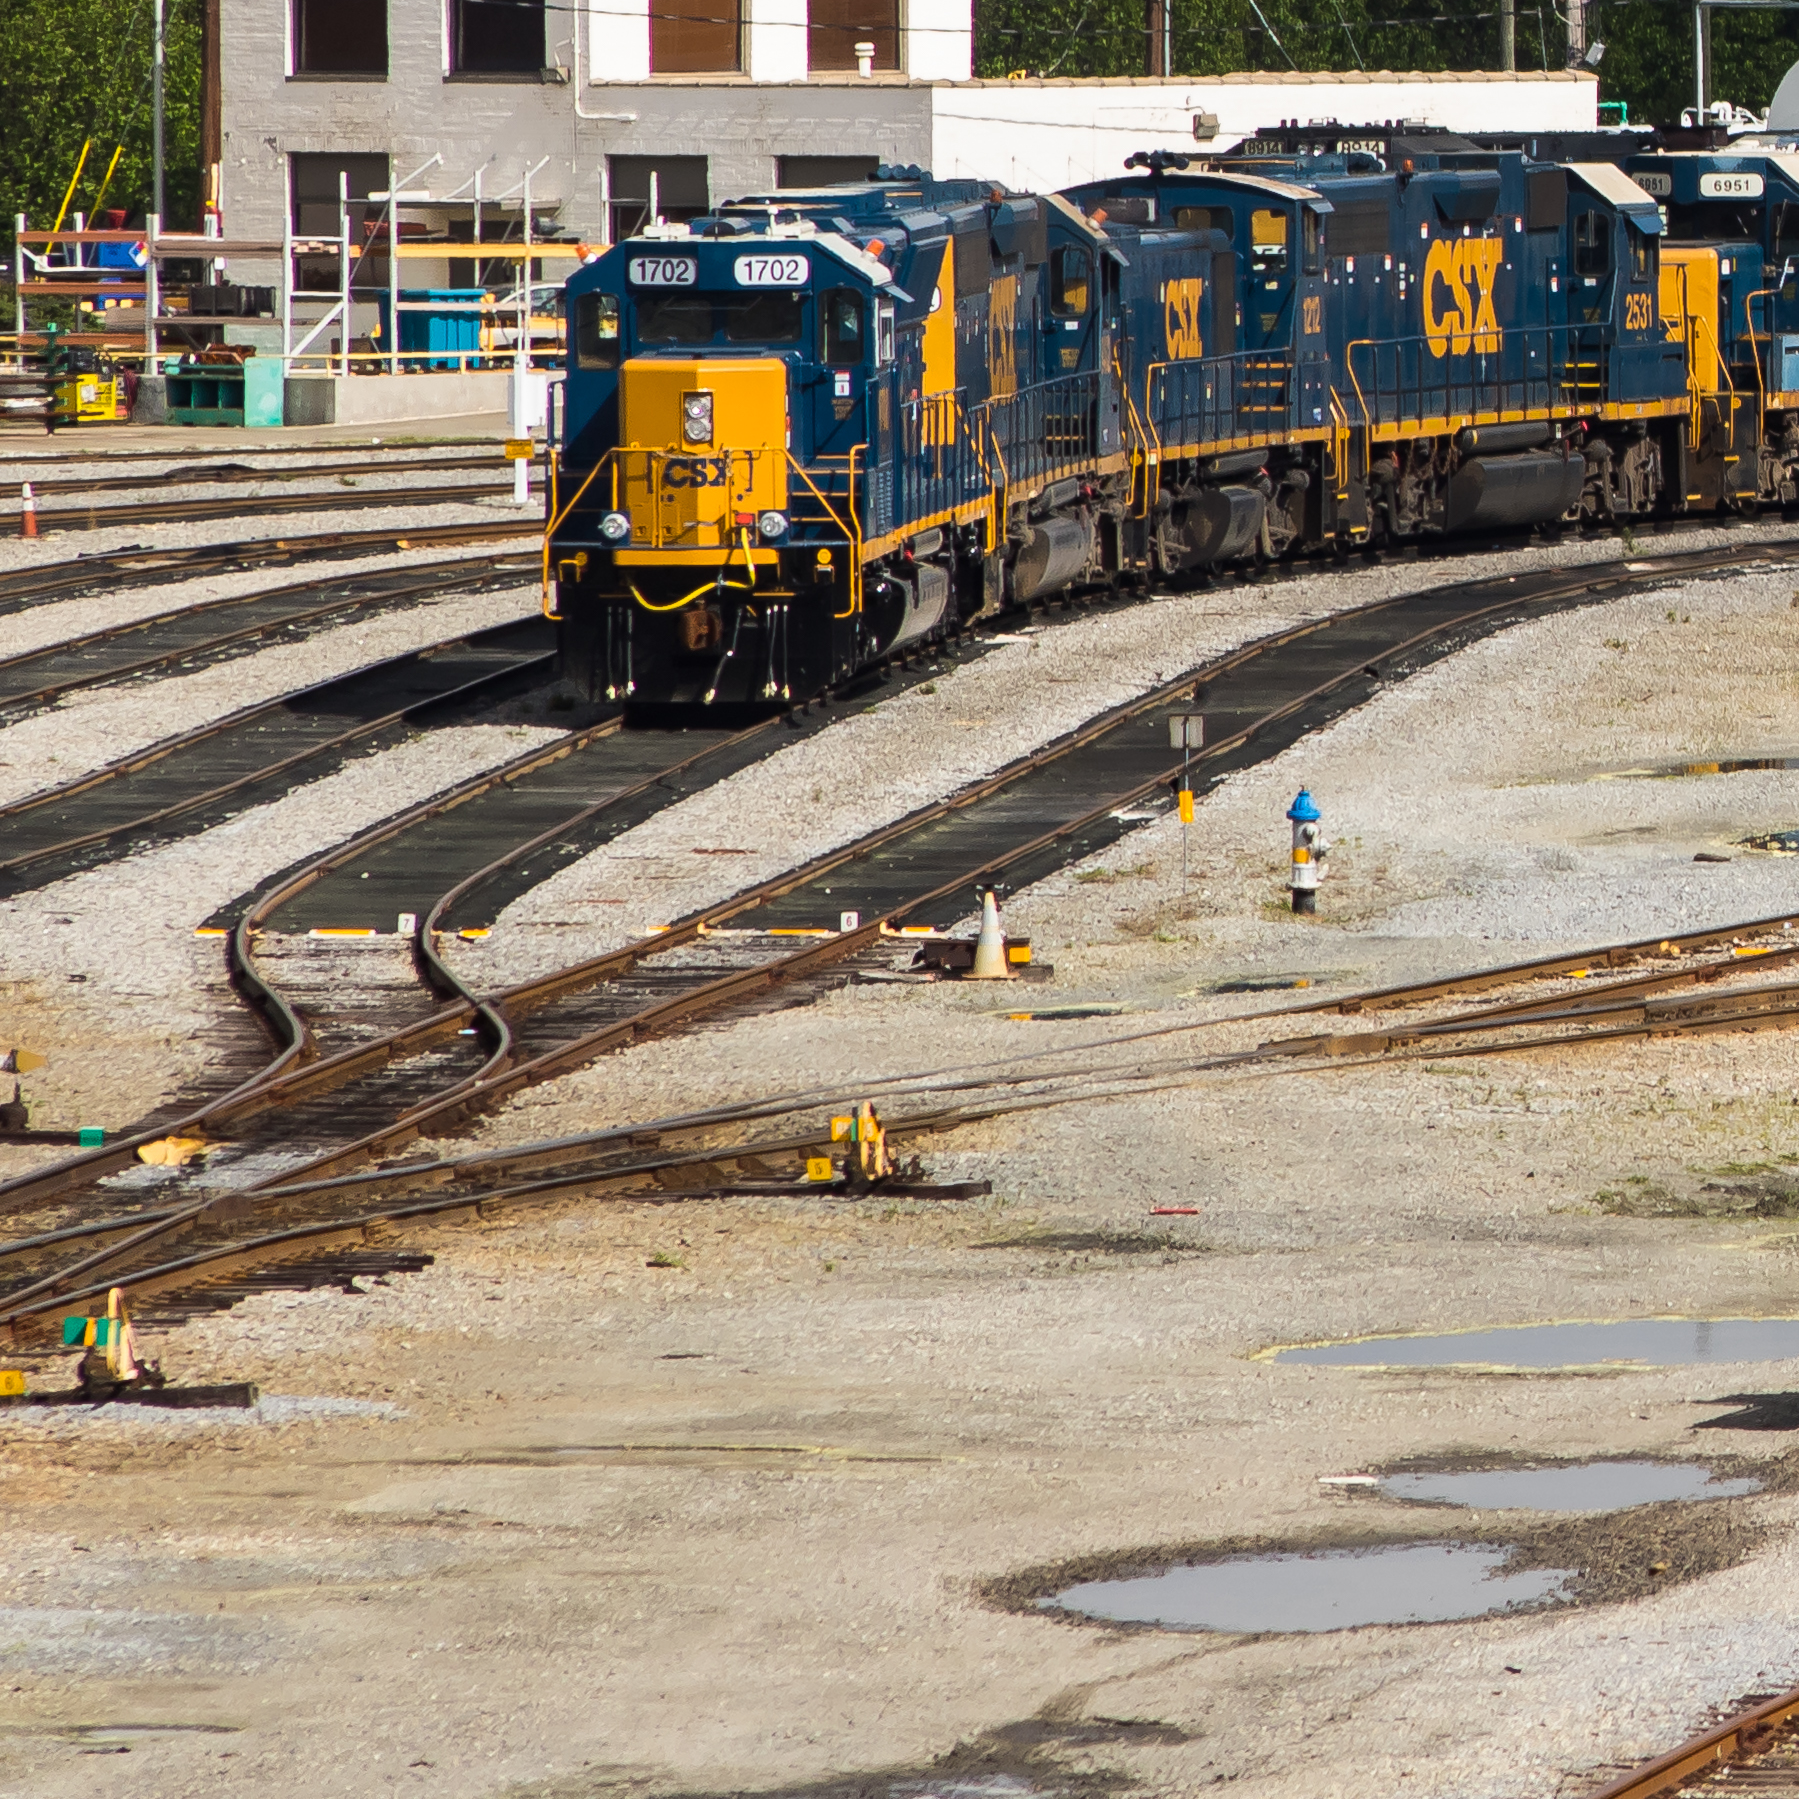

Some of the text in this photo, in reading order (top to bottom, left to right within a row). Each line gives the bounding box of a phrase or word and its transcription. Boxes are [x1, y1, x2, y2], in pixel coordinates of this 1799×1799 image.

[1714, 178, 1750, 193] 6951
[637, 258, 690, 283] 1702
[742, 258, 800, 283] 1702
[1423, 237, 1503, 358] CSX
[1625, 293, 1654, 331] 2531
[1165, 278, 1203, 359] CSX
[663, 459, 727, 489] CSX
